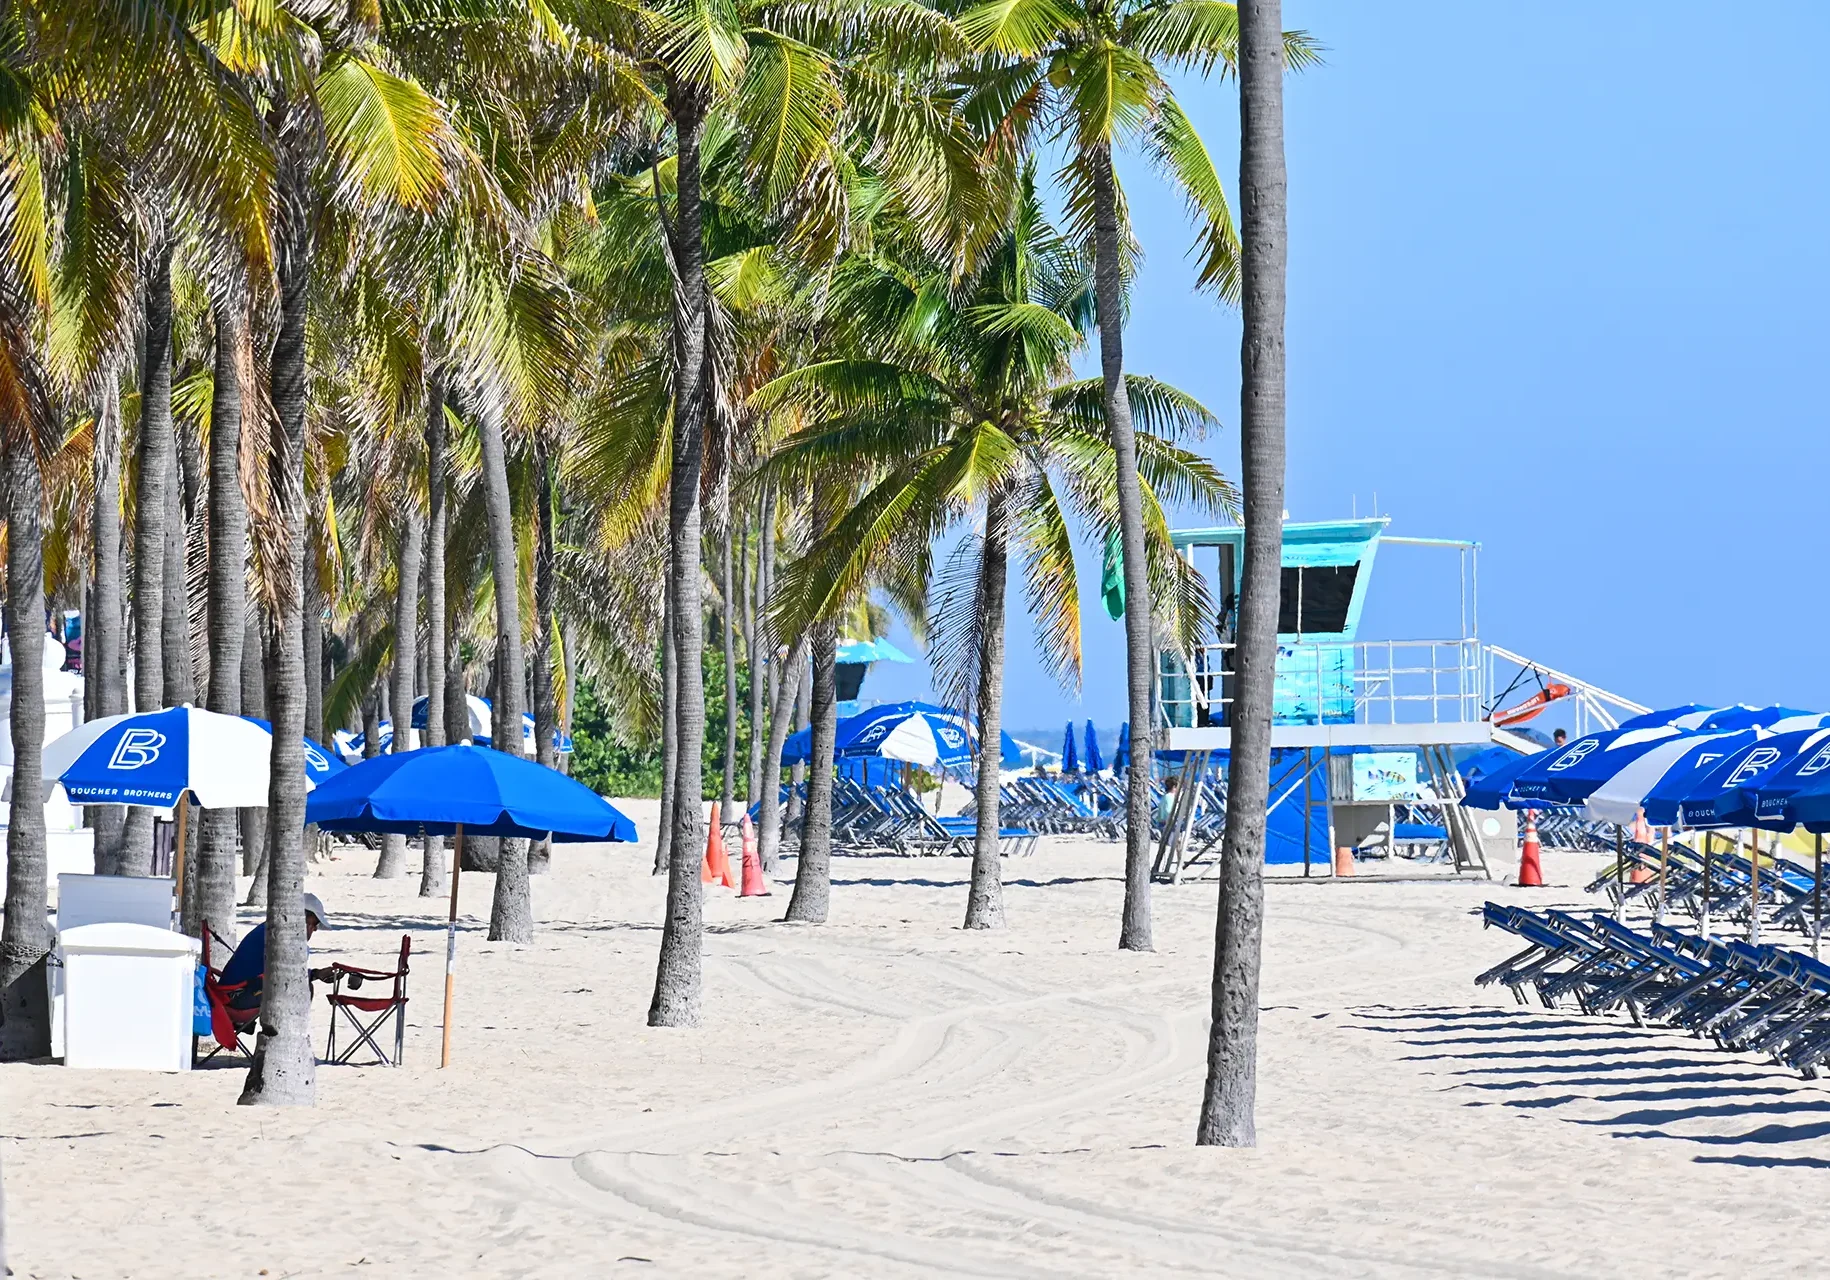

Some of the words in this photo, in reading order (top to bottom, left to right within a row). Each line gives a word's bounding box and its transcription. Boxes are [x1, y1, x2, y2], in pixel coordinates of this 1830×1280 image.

[70, 787, 118, 796] BOUCHER
[123, 788, 173, 800] BROTHERS
[1688, 808, 1716, 818] BOUCH
